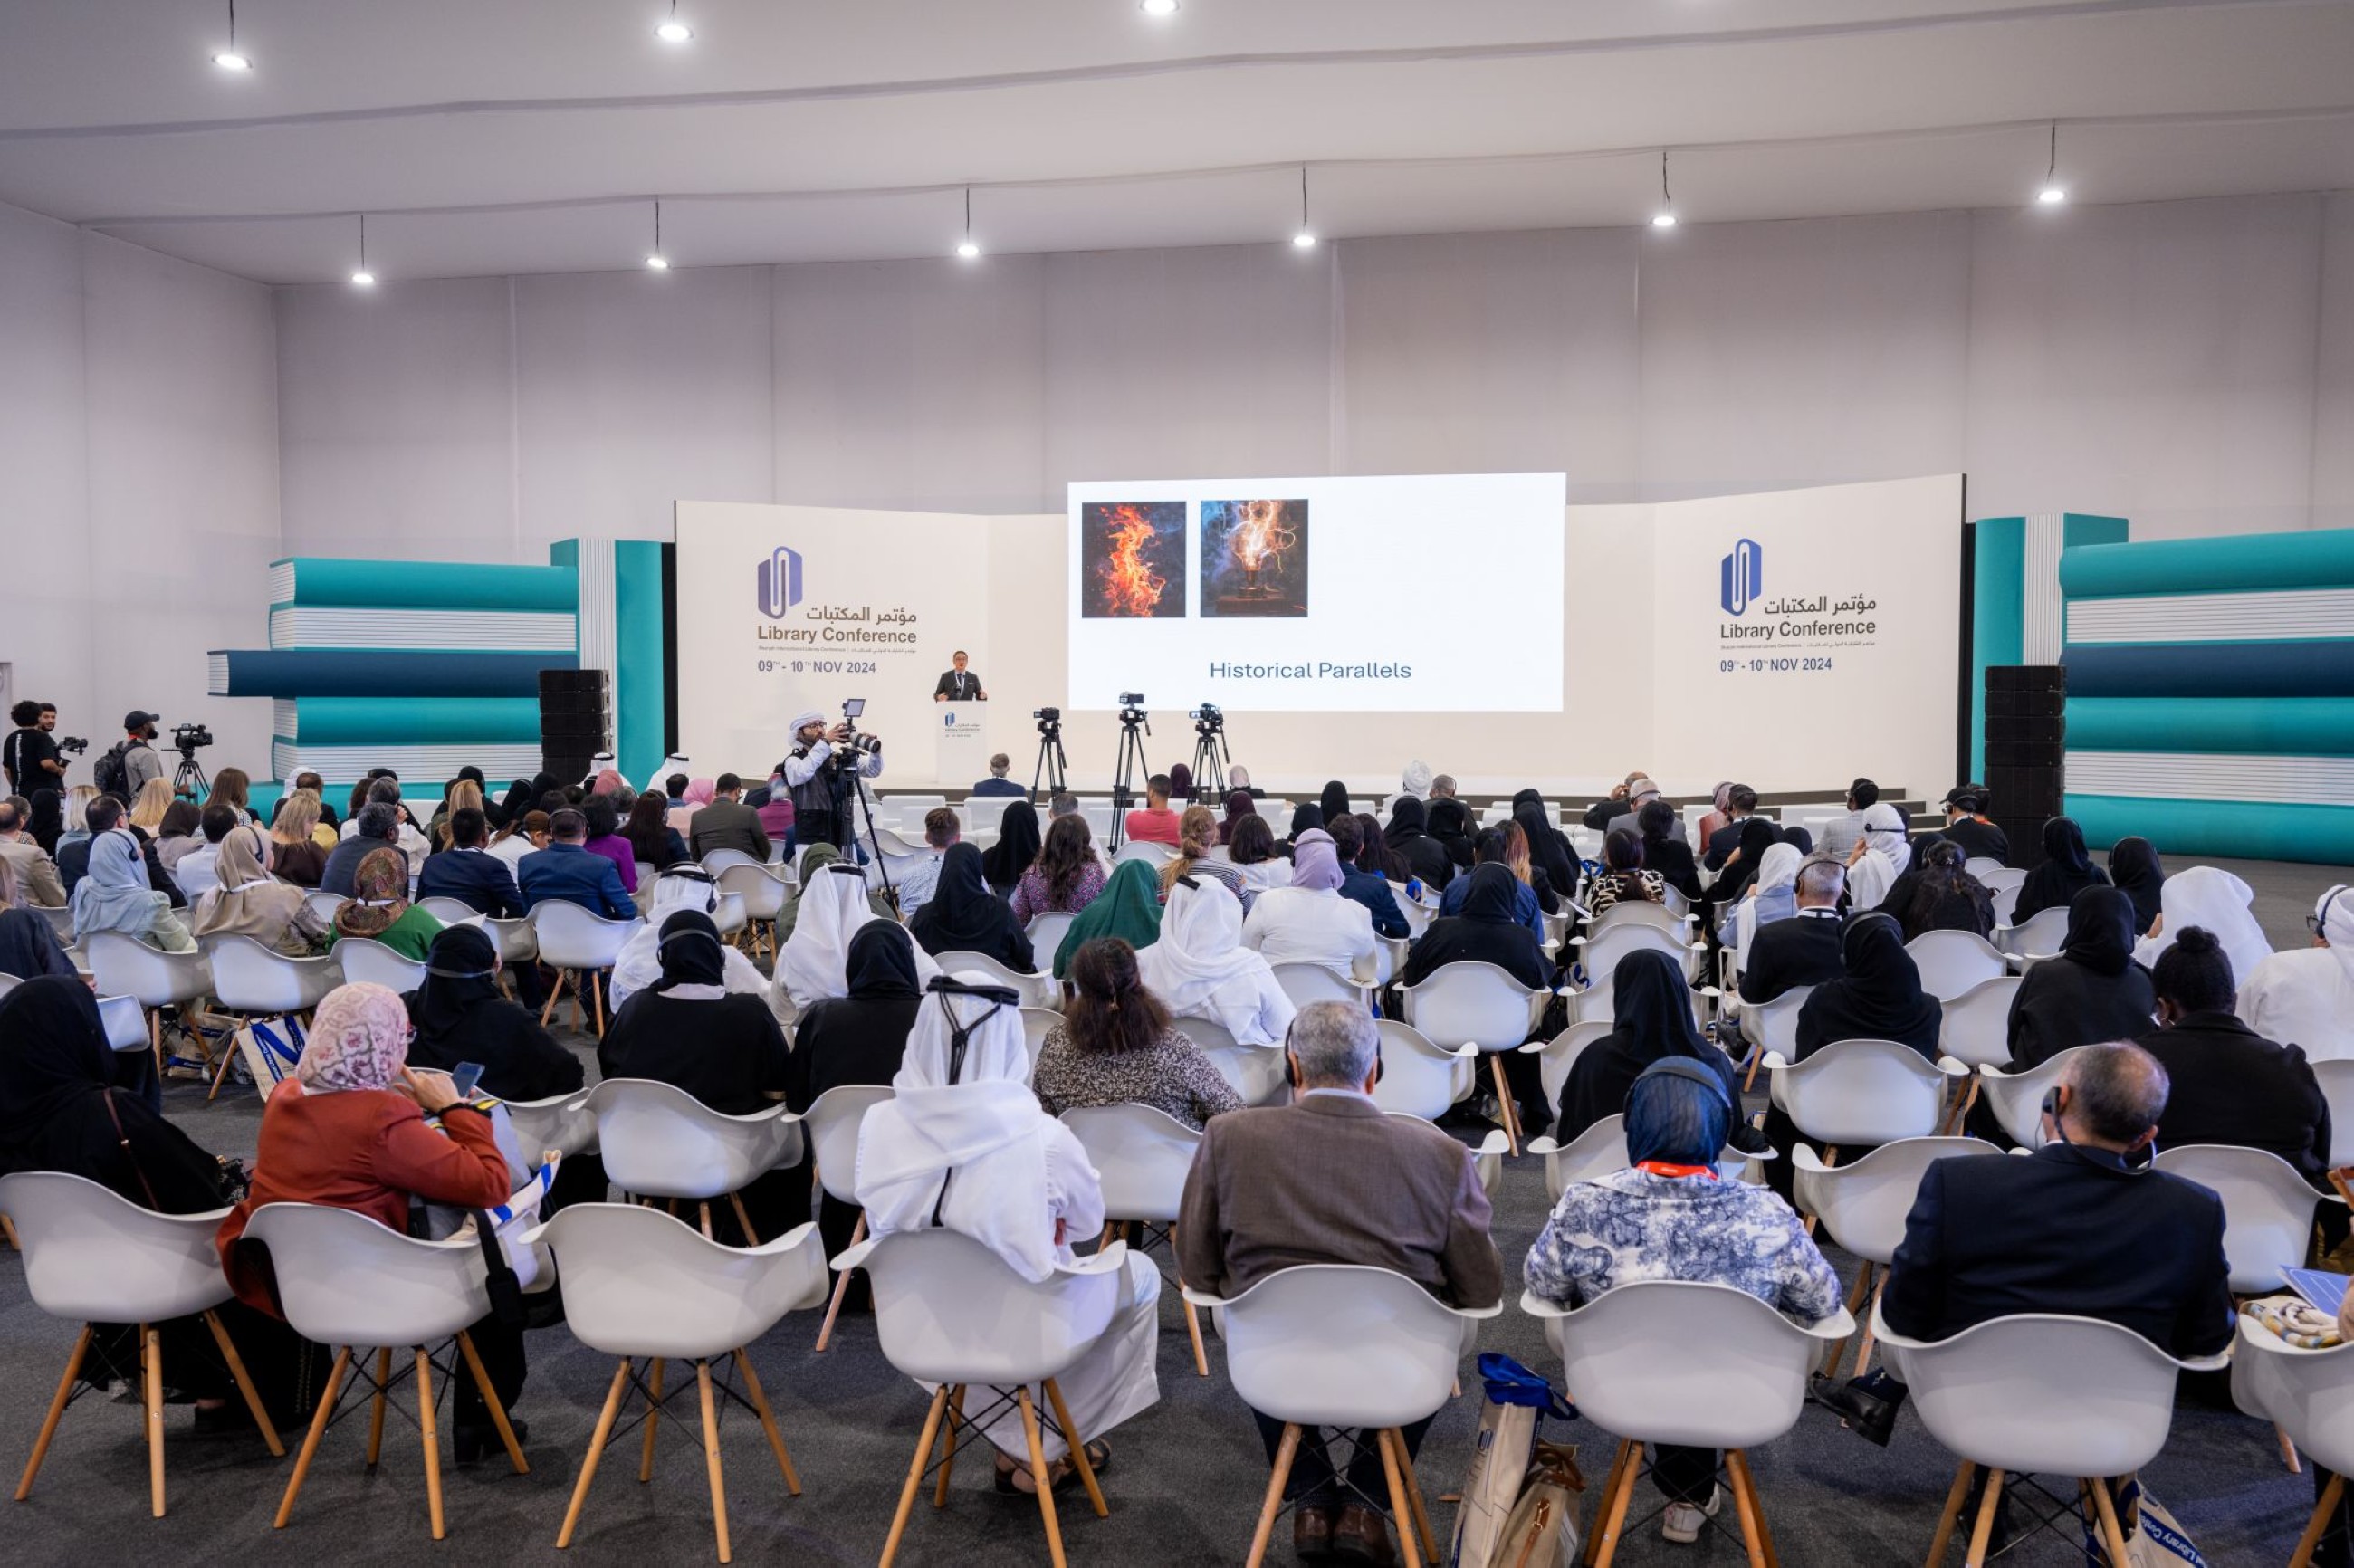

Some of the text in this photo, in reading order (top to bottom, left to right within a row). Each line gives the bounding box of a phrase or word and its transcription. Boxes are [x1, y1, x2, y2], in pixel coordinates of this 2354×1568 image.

[1765, 593, 1876, 618] مؤتمر المكتبات
[806, 605, 917, 626] مؤتمر المكتبات
[758, 626, 917, 644] Library Conference
[1720, 620, 1876, 641] Library Conference
[813, 661, 843, 673] NOV
[846, 662, 876, 673] 2024
[1210, 662, 1411, 679] Historical Parallels
[1771, 658, 1798, 671] NOV
[1803, 657, 1832, 671] 2024
[2163, 1533, 2196, 1561] Library
